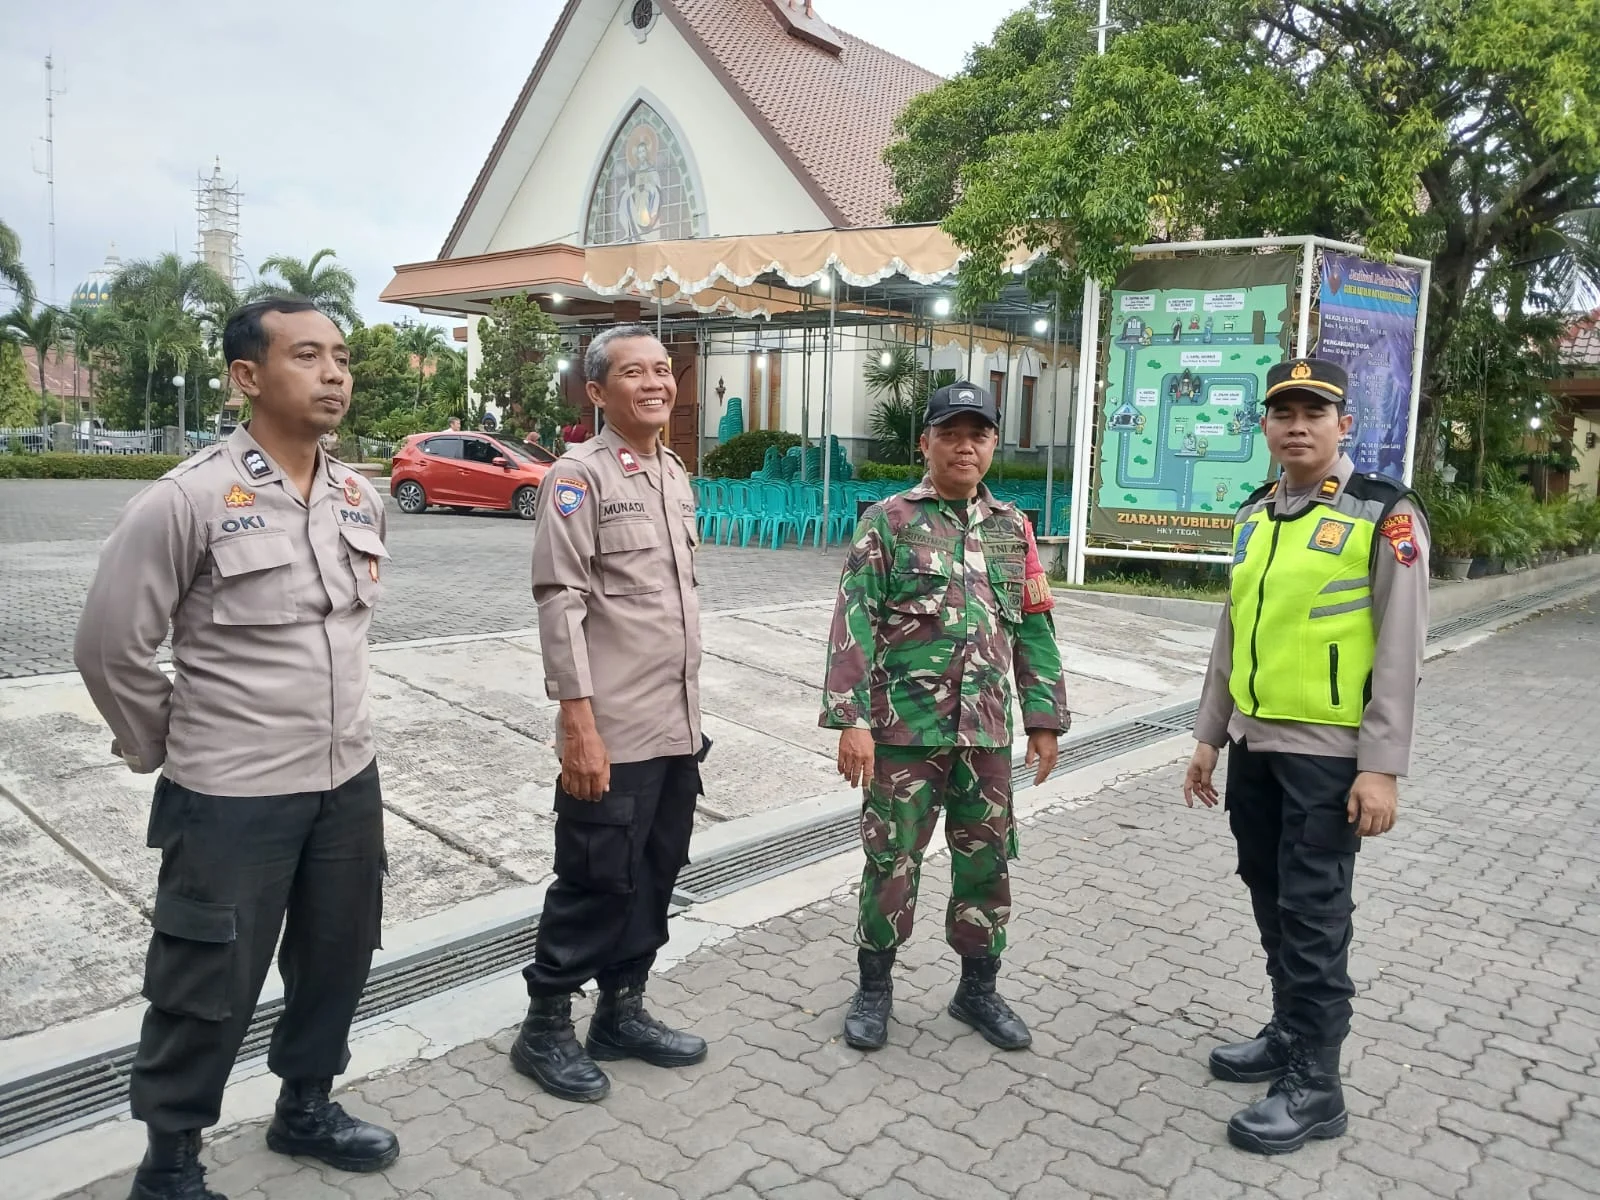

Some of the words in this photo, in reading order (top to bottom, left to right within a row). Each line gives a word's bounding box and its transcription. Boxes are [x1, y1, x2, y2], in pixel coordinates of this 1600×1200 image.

[603, 503, 646, 517] MUNADI
[221, 514, 266, 533] OKI
[1117, 512, 1168, 527] ZIARAH
[1170, 515, 1234, 529] YUBILEU
[1156, 527, 1173, 536] HKY
[1176, 528, 1201, 537] TEGAL
[988, 544, 1007, 554] TNI
